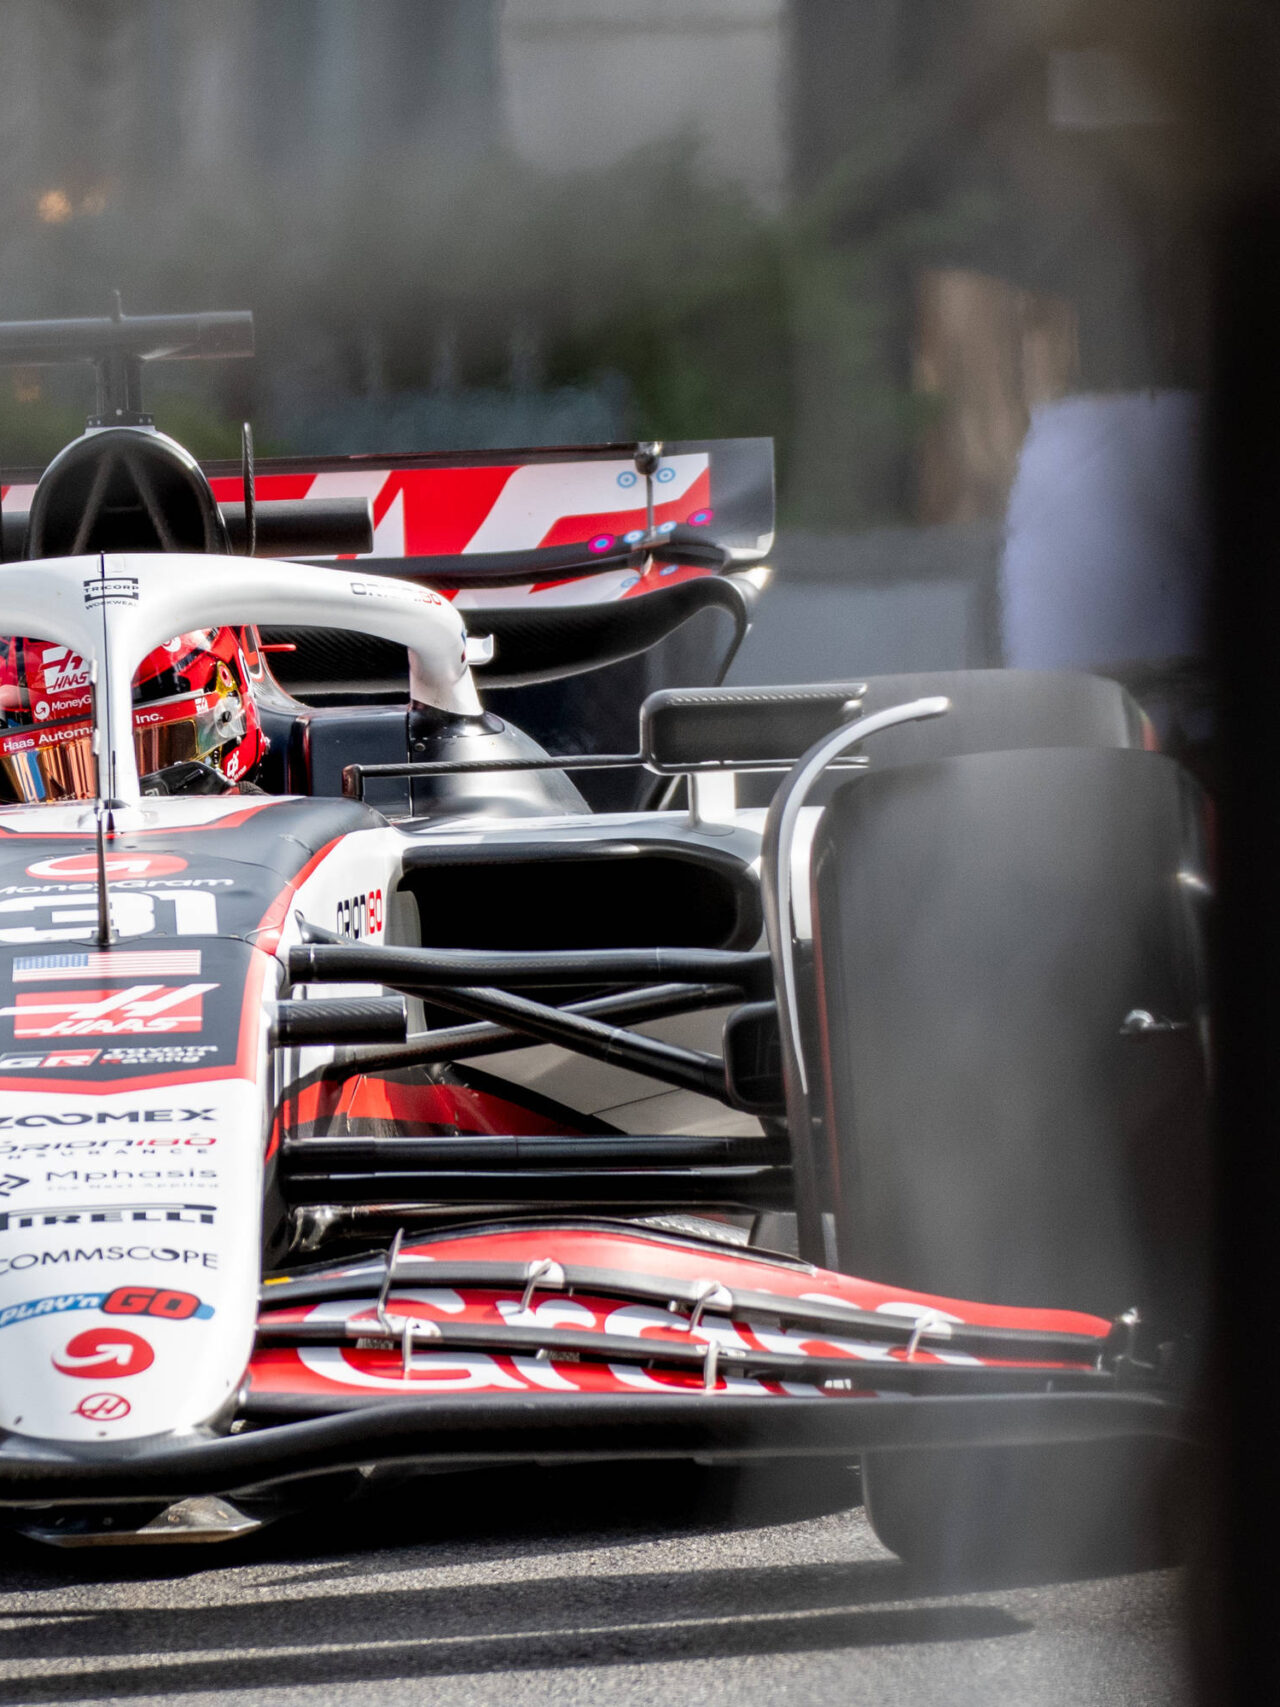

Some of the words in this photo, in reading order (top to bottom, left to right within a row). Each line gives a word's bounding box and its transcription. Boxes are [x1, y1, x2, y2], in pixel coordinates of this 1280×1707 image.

[84, 584, 139, 593] TRICORP
[52, 671, 90, 690] HAAS
[51, 694, 91, 711] MoneyG
[3, 738, 35, 752] Haas
[135, 713, 164, 724] Inc.
[40, 1018, 179, 1036] HAAS
[46, 1168, 218, 1183] Mphasis
[100, 1286, 202, 1320] GO
